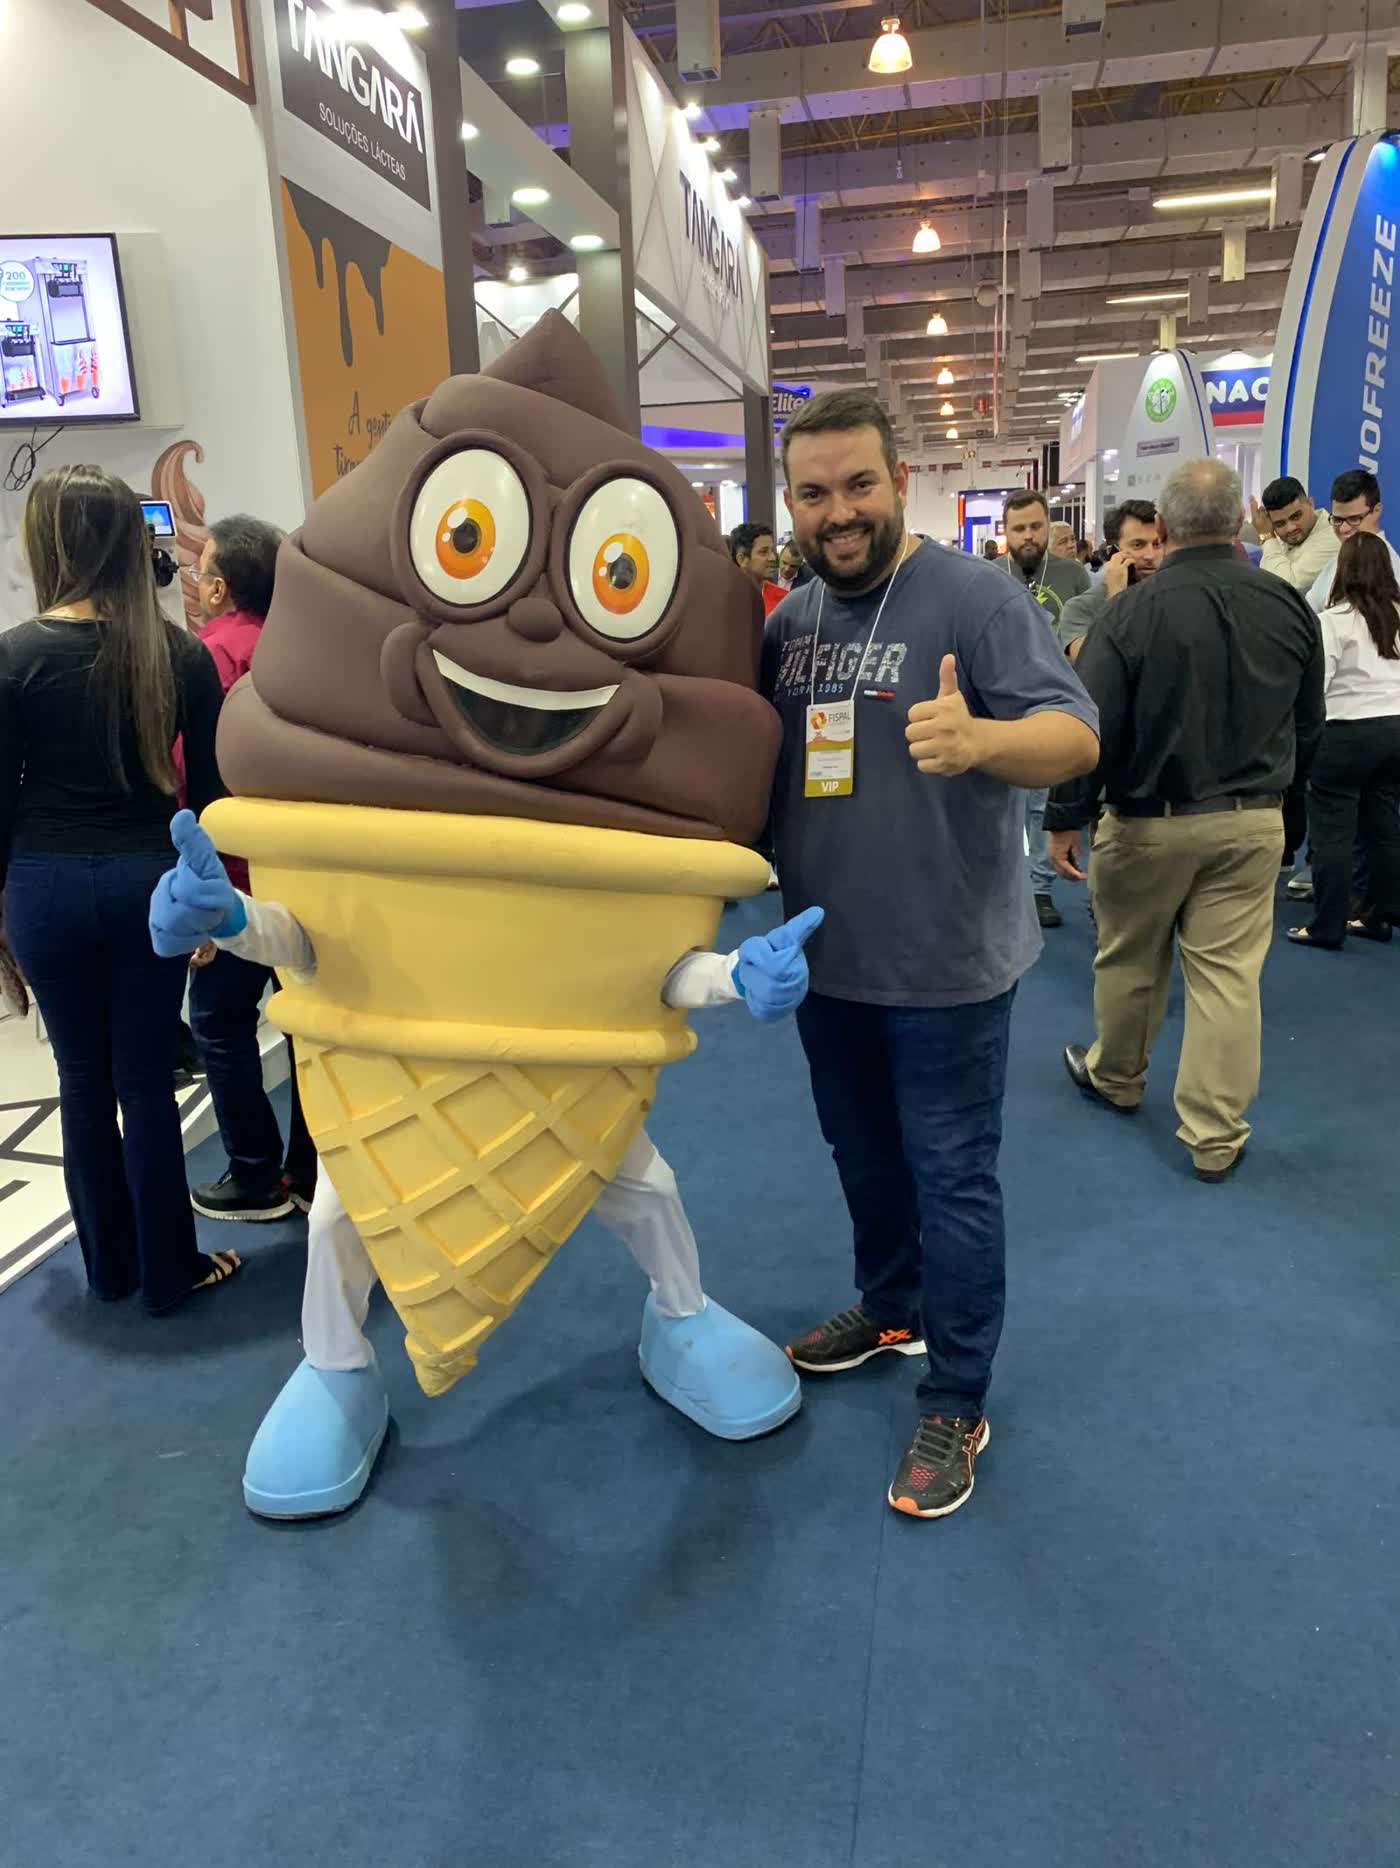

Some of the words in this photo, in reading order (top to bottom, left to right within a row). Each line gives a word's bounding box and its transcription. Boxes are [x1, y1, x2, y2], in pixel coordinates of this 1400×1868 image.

[319, 102, 369, 153] SOLUÇÕES
[370, 142, 406, 181] LÁCTEAS
[5, 270, 26, 281] 200
[348, 390, 361, 436] A
[817, 683, 844, 694] 1985
[821, 780, 840, 793] VIP
